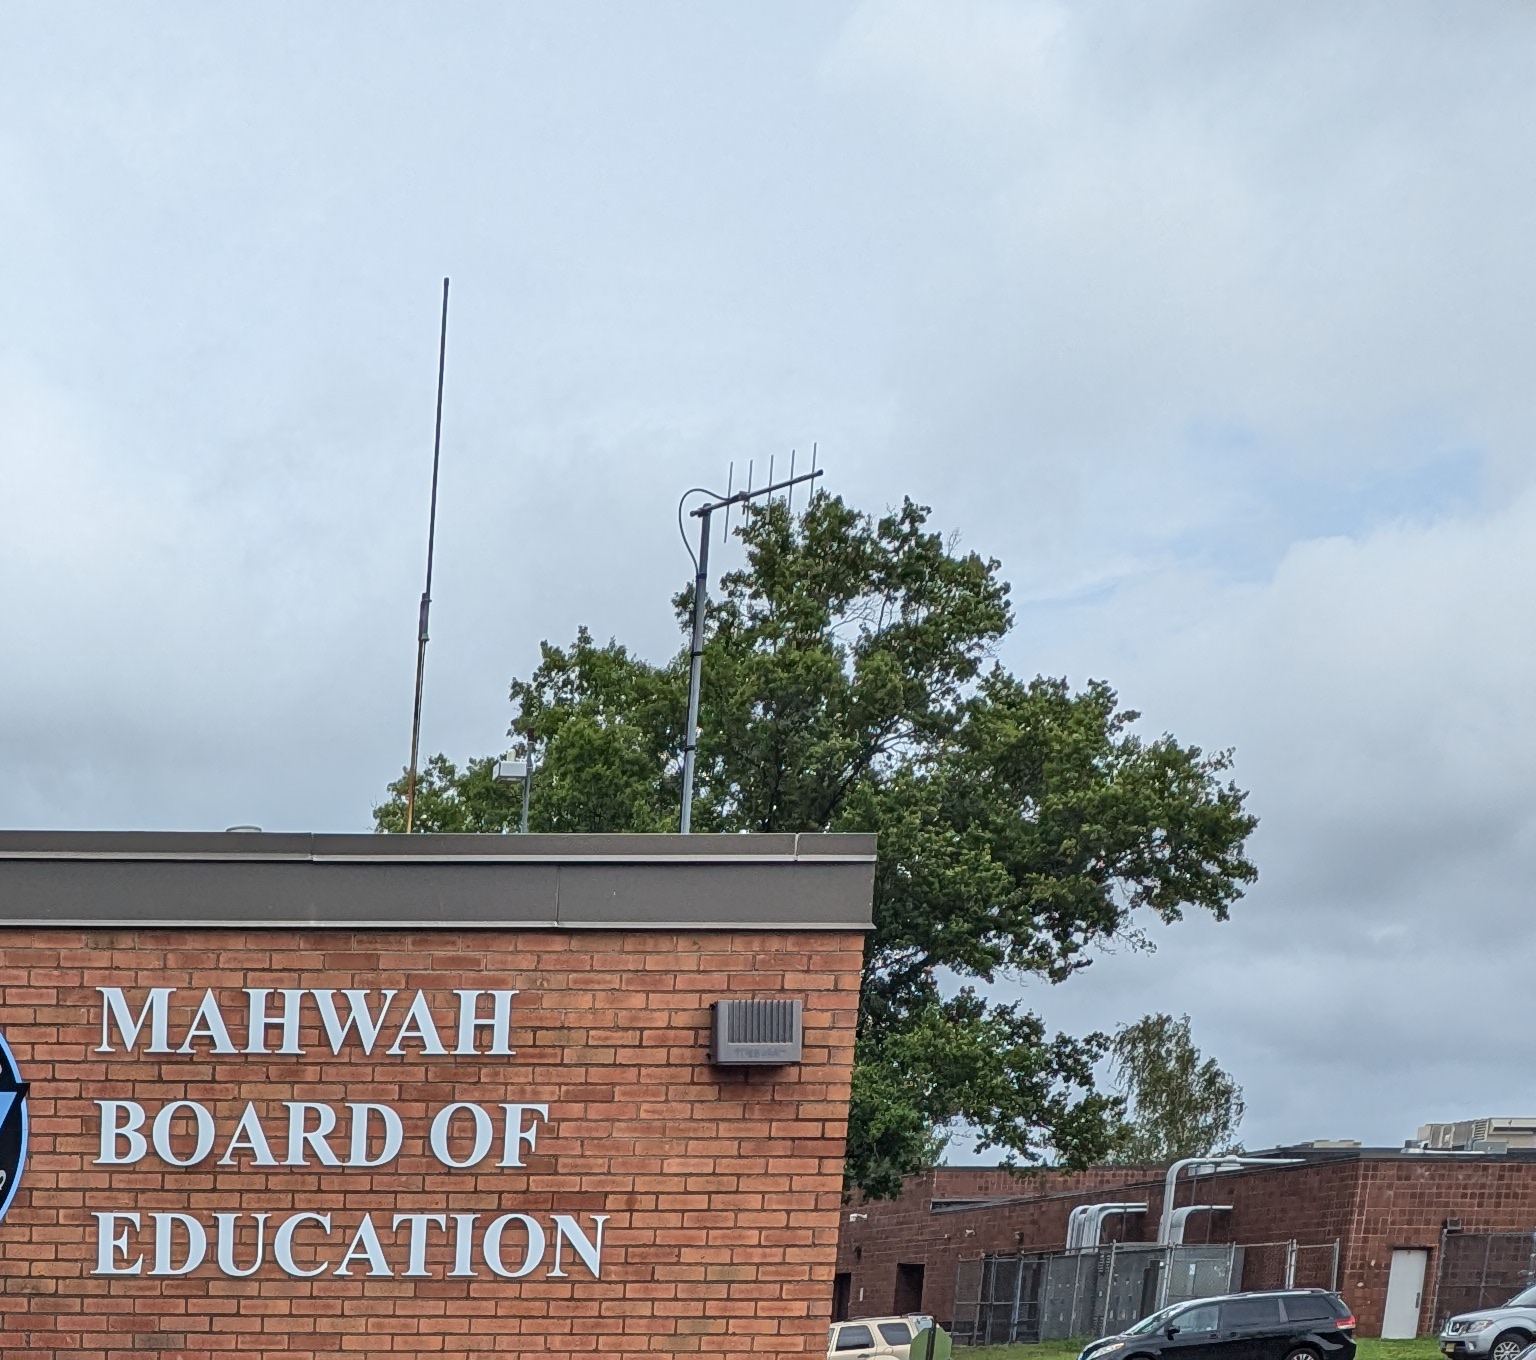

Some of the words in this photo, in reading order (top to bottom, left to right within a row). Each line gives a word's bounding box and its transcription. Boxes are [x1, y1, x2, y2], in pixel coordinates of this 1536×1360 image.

[93, 986, 521, 1056] MAHWAH
[92, 1100, 404, 1168] BOARD
[429, 1101, 550, 1169] OF
[89, 1211, 612, 1280] EDUCATION
